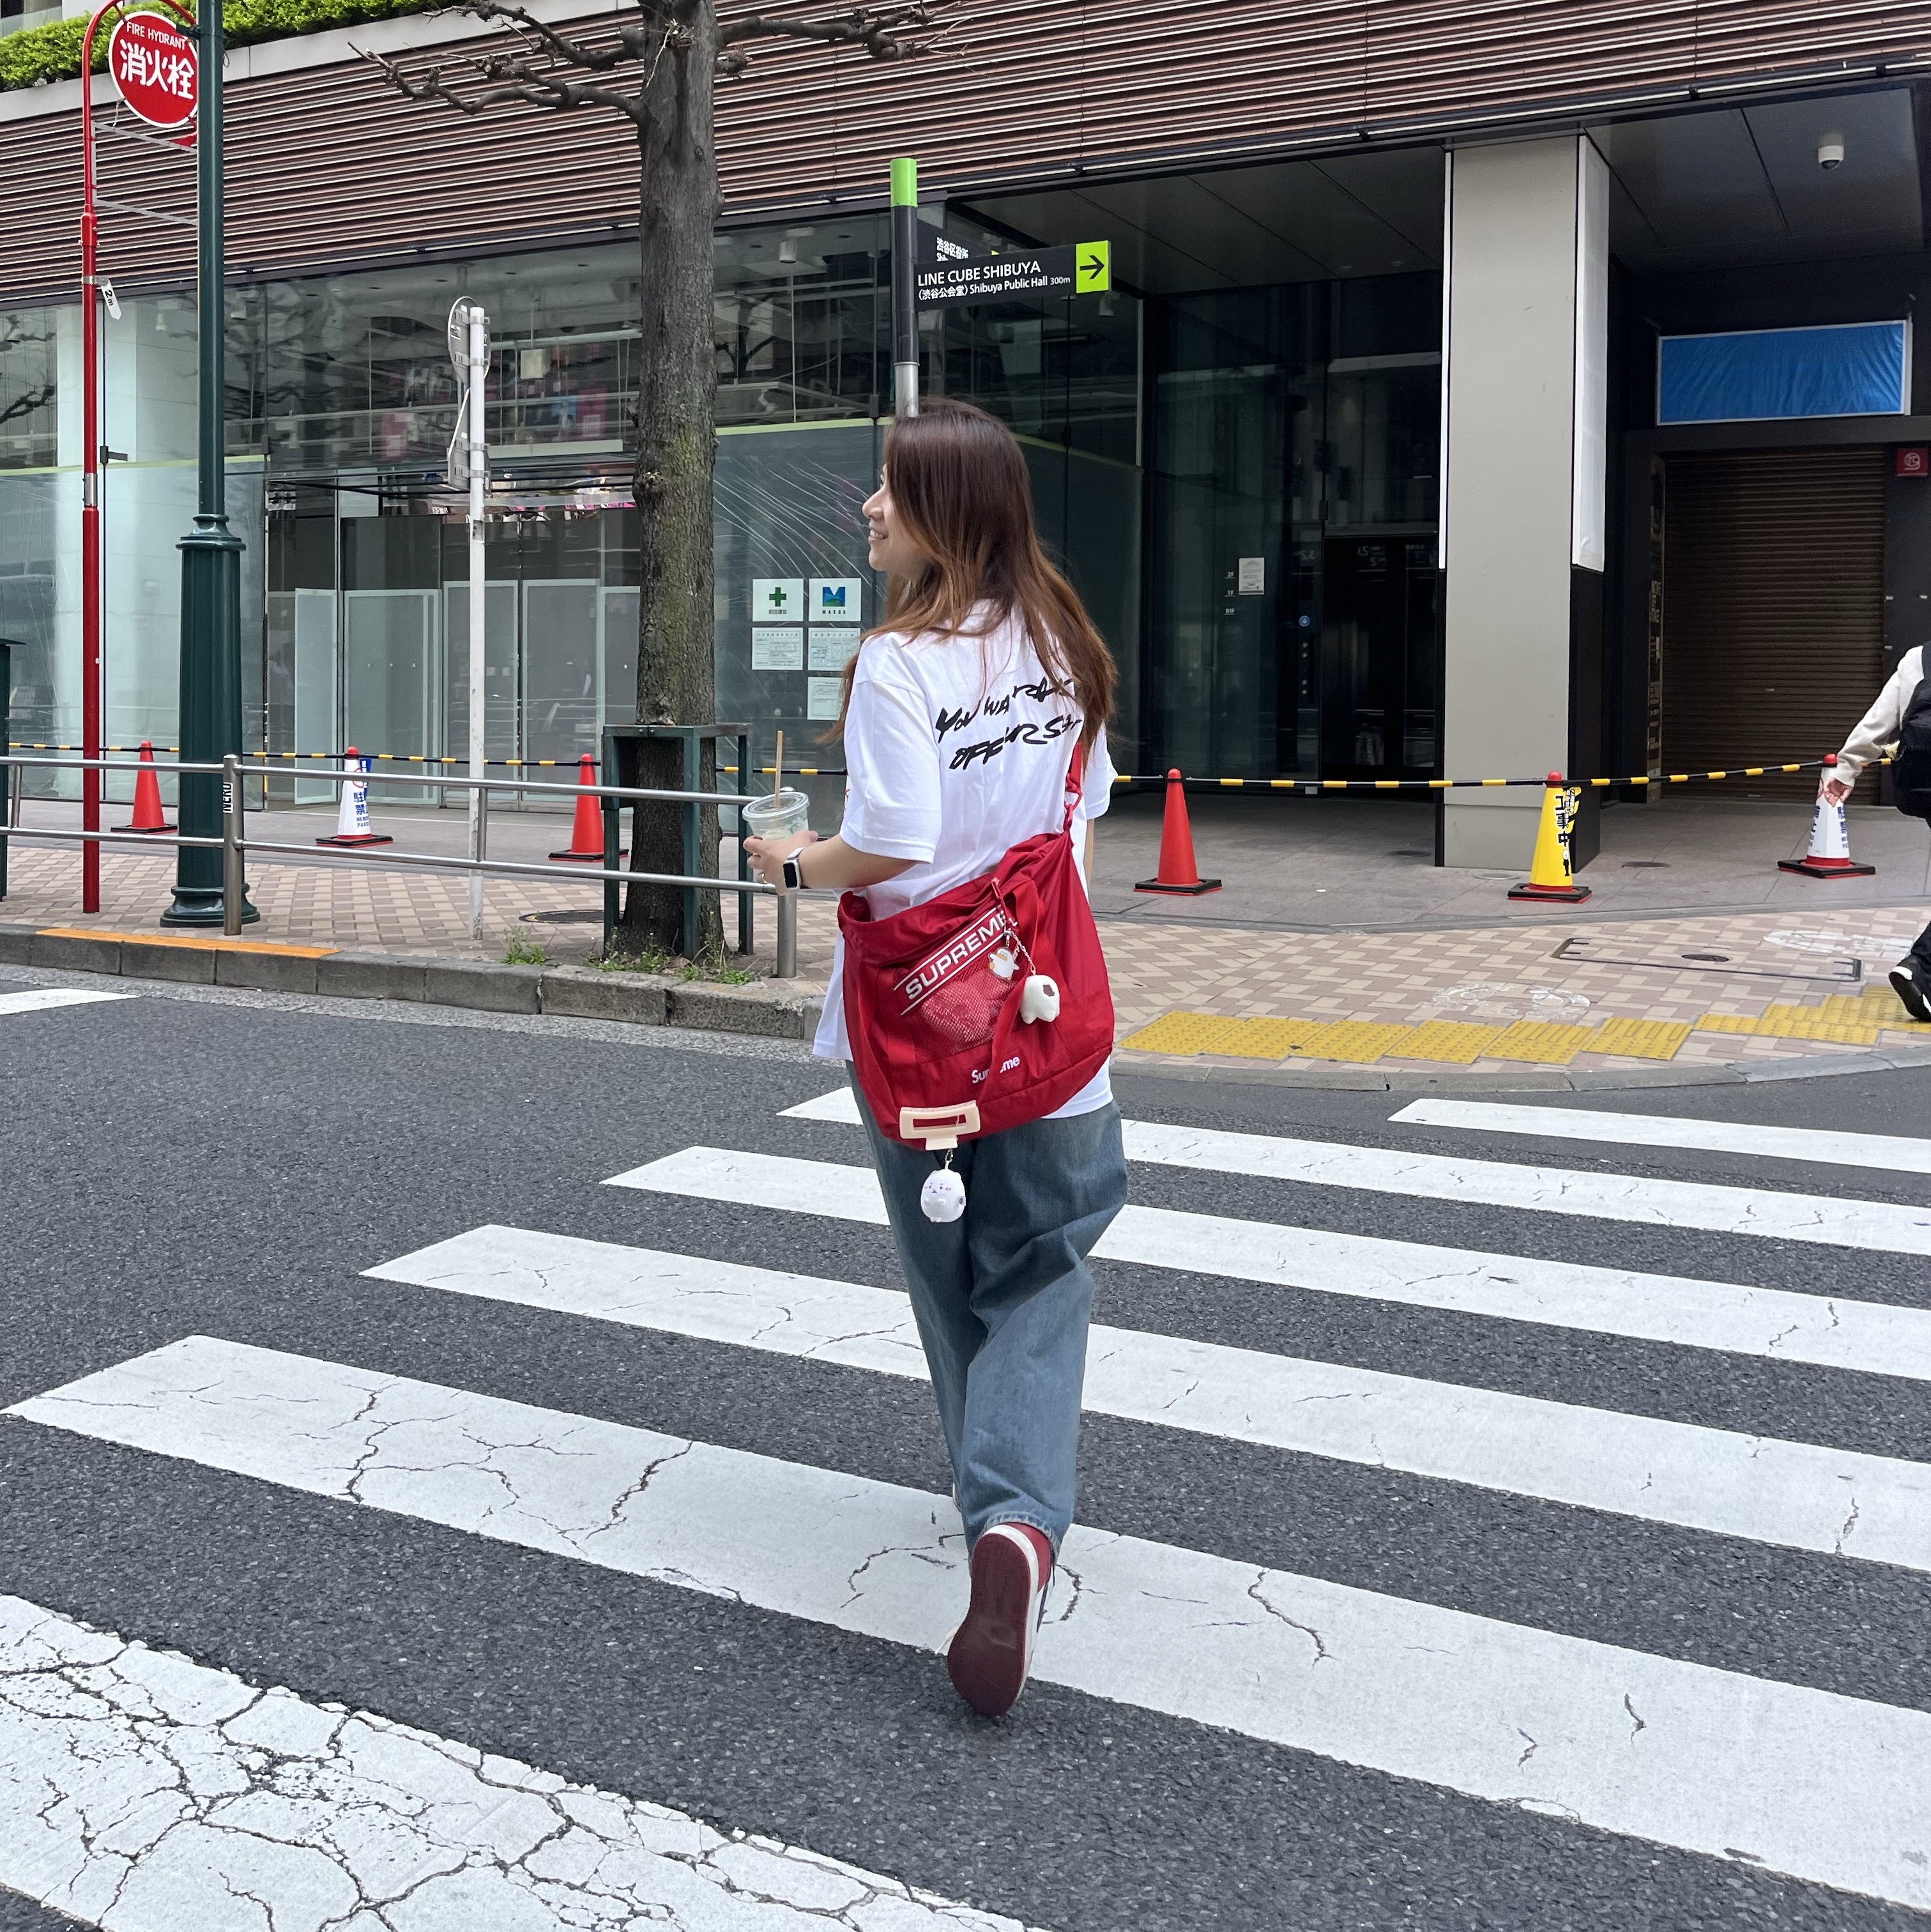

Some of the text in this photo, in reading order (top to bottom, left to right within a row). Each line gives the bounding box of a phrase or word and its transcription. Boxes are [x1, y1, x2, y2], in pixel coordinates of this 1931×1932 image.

[127, 21, 187, 50] FIRE HYDRANT
[119, 38, 195, 100] 消火栓
[918, 261, 1041, 286] LINE CUBE SHIBUYA
[970, 282, 1003, 294] Shibuya
[1004, 278, 1030, 291] Public
[1031, 275, 1048, 287] Hall
[1049, 276, 1071, 285] 300m
